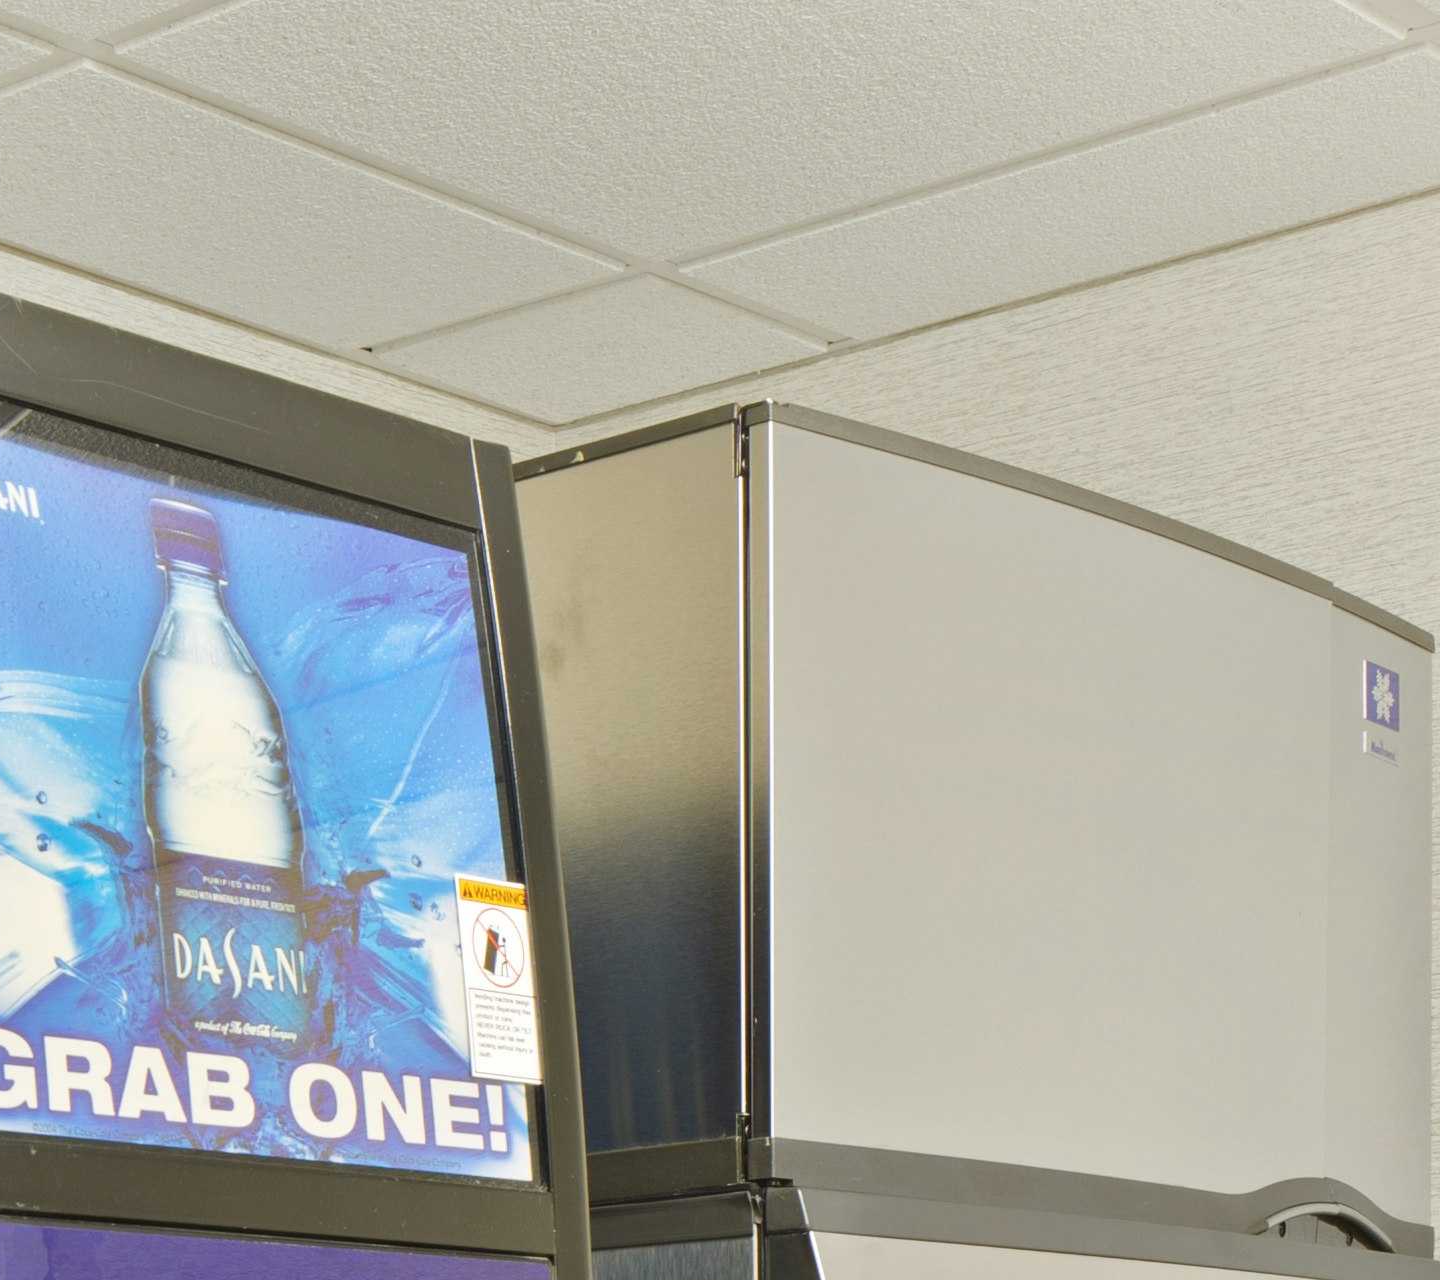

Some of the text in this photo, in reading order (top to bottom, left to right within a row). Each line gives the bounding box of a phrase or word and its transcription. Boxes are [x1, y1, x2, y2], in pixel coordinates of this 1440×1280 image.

[202, 876, 271, 892] PURIFIED WATER
[473, 884, 526, 906] WARNING
[173, 928, 307, 999] DASANI
[287, 1062, 511, 1153] ONE!
